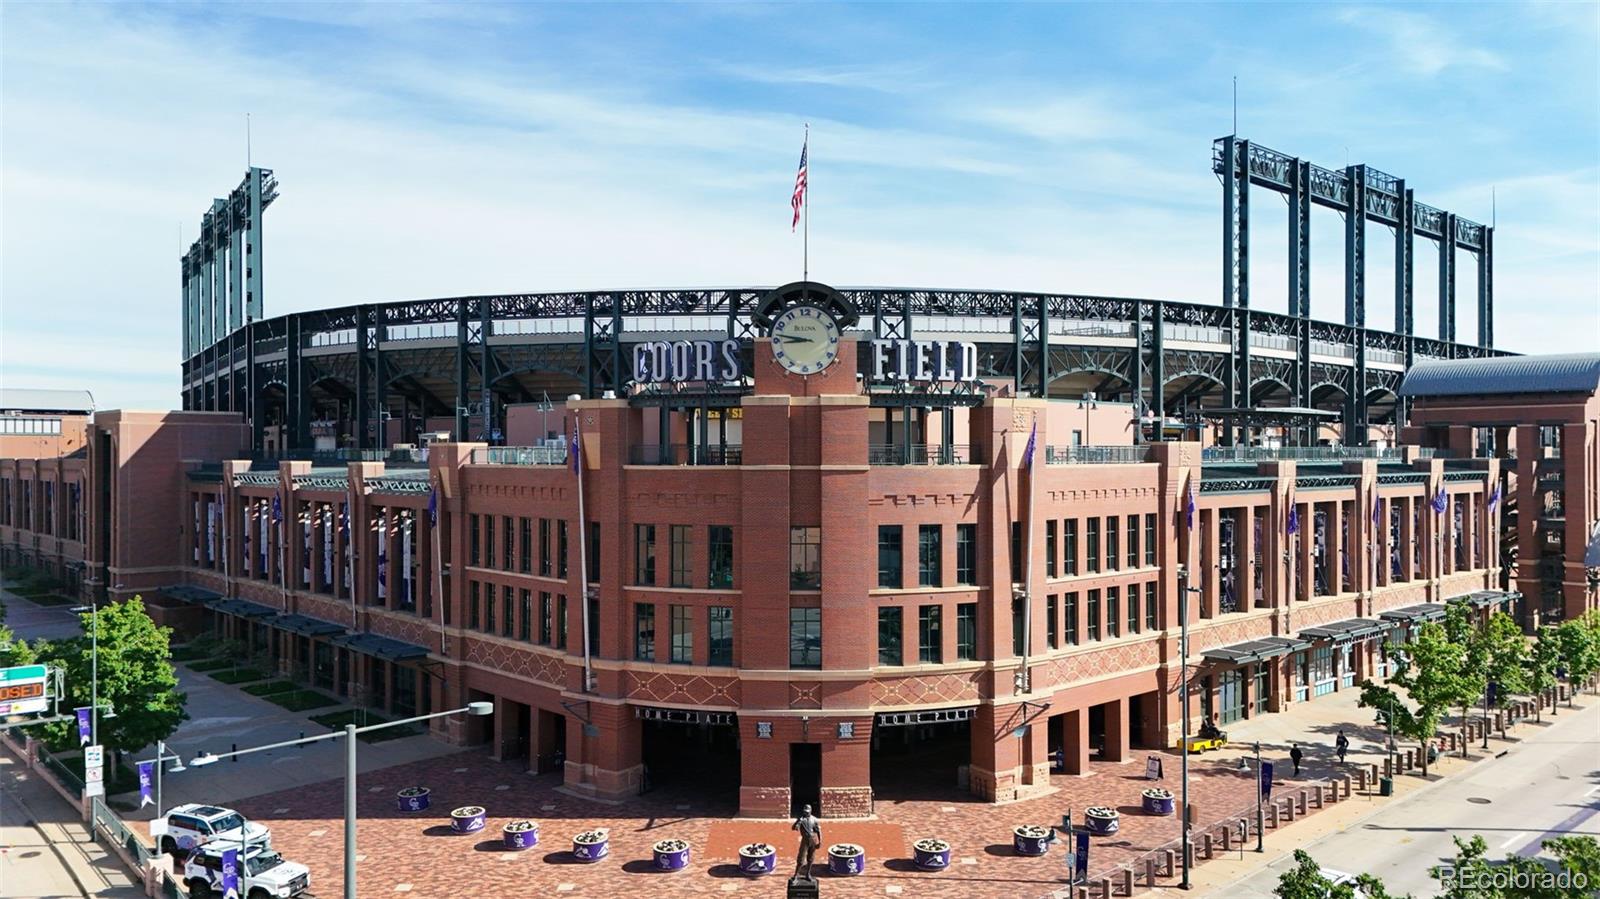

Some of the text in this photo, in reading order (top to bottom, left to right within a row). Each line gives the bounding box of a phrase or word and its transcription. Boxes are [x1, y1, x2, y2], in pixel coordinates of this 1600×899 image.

[786, 312, 795, 320] 11
[776, 321, 785, 331] 10
[826, 322, 834, 331] 2
[776, 351, 784, 359] 8
[826, 351, 833, 359] 4
[633, 339, 977, 382] COORS FIELD
[816, 361, 823, 369] 5
[635, 707, 731, 724] HOME PLATE
[881, 714, 920, 725] HOME
